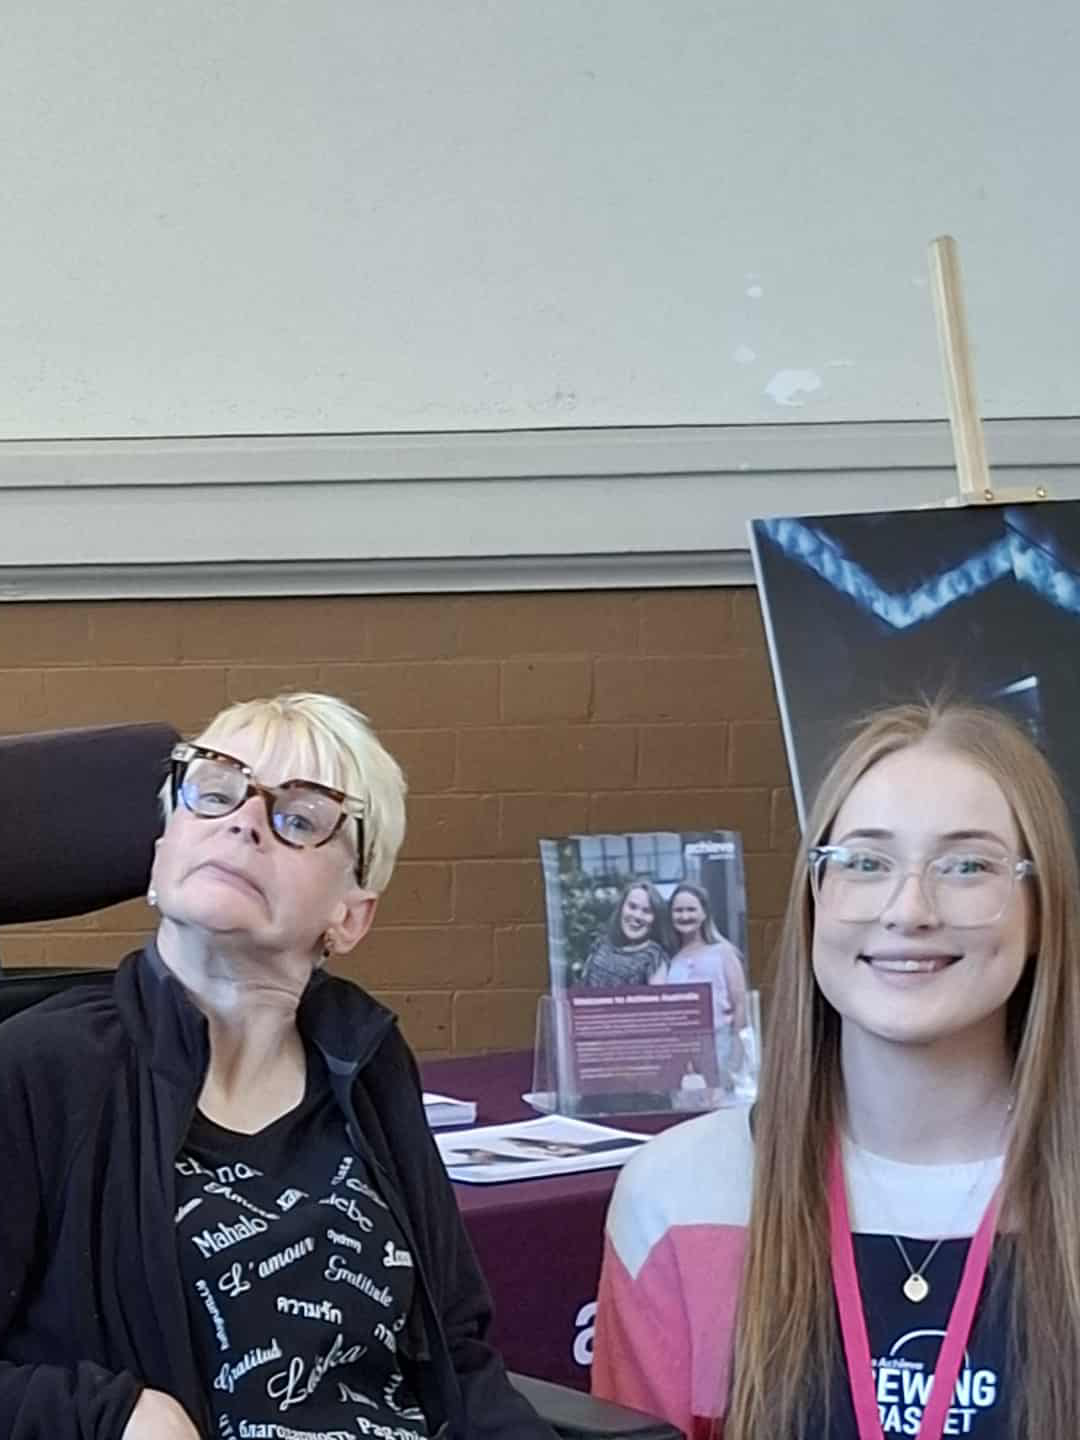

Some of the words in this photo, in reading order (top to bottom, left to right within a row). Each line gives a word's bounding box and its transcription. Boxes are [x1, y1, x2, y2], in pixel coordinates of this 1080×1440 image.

[191, 1214, 269, 1259] Mahalo
[217, 1236, 316, 1297] L'amour
[323, 1254, 394, 1307] Gratitude
[872, 1367, 997, 1408] EWNG
[877, 1404, 978, 1436] ASET
